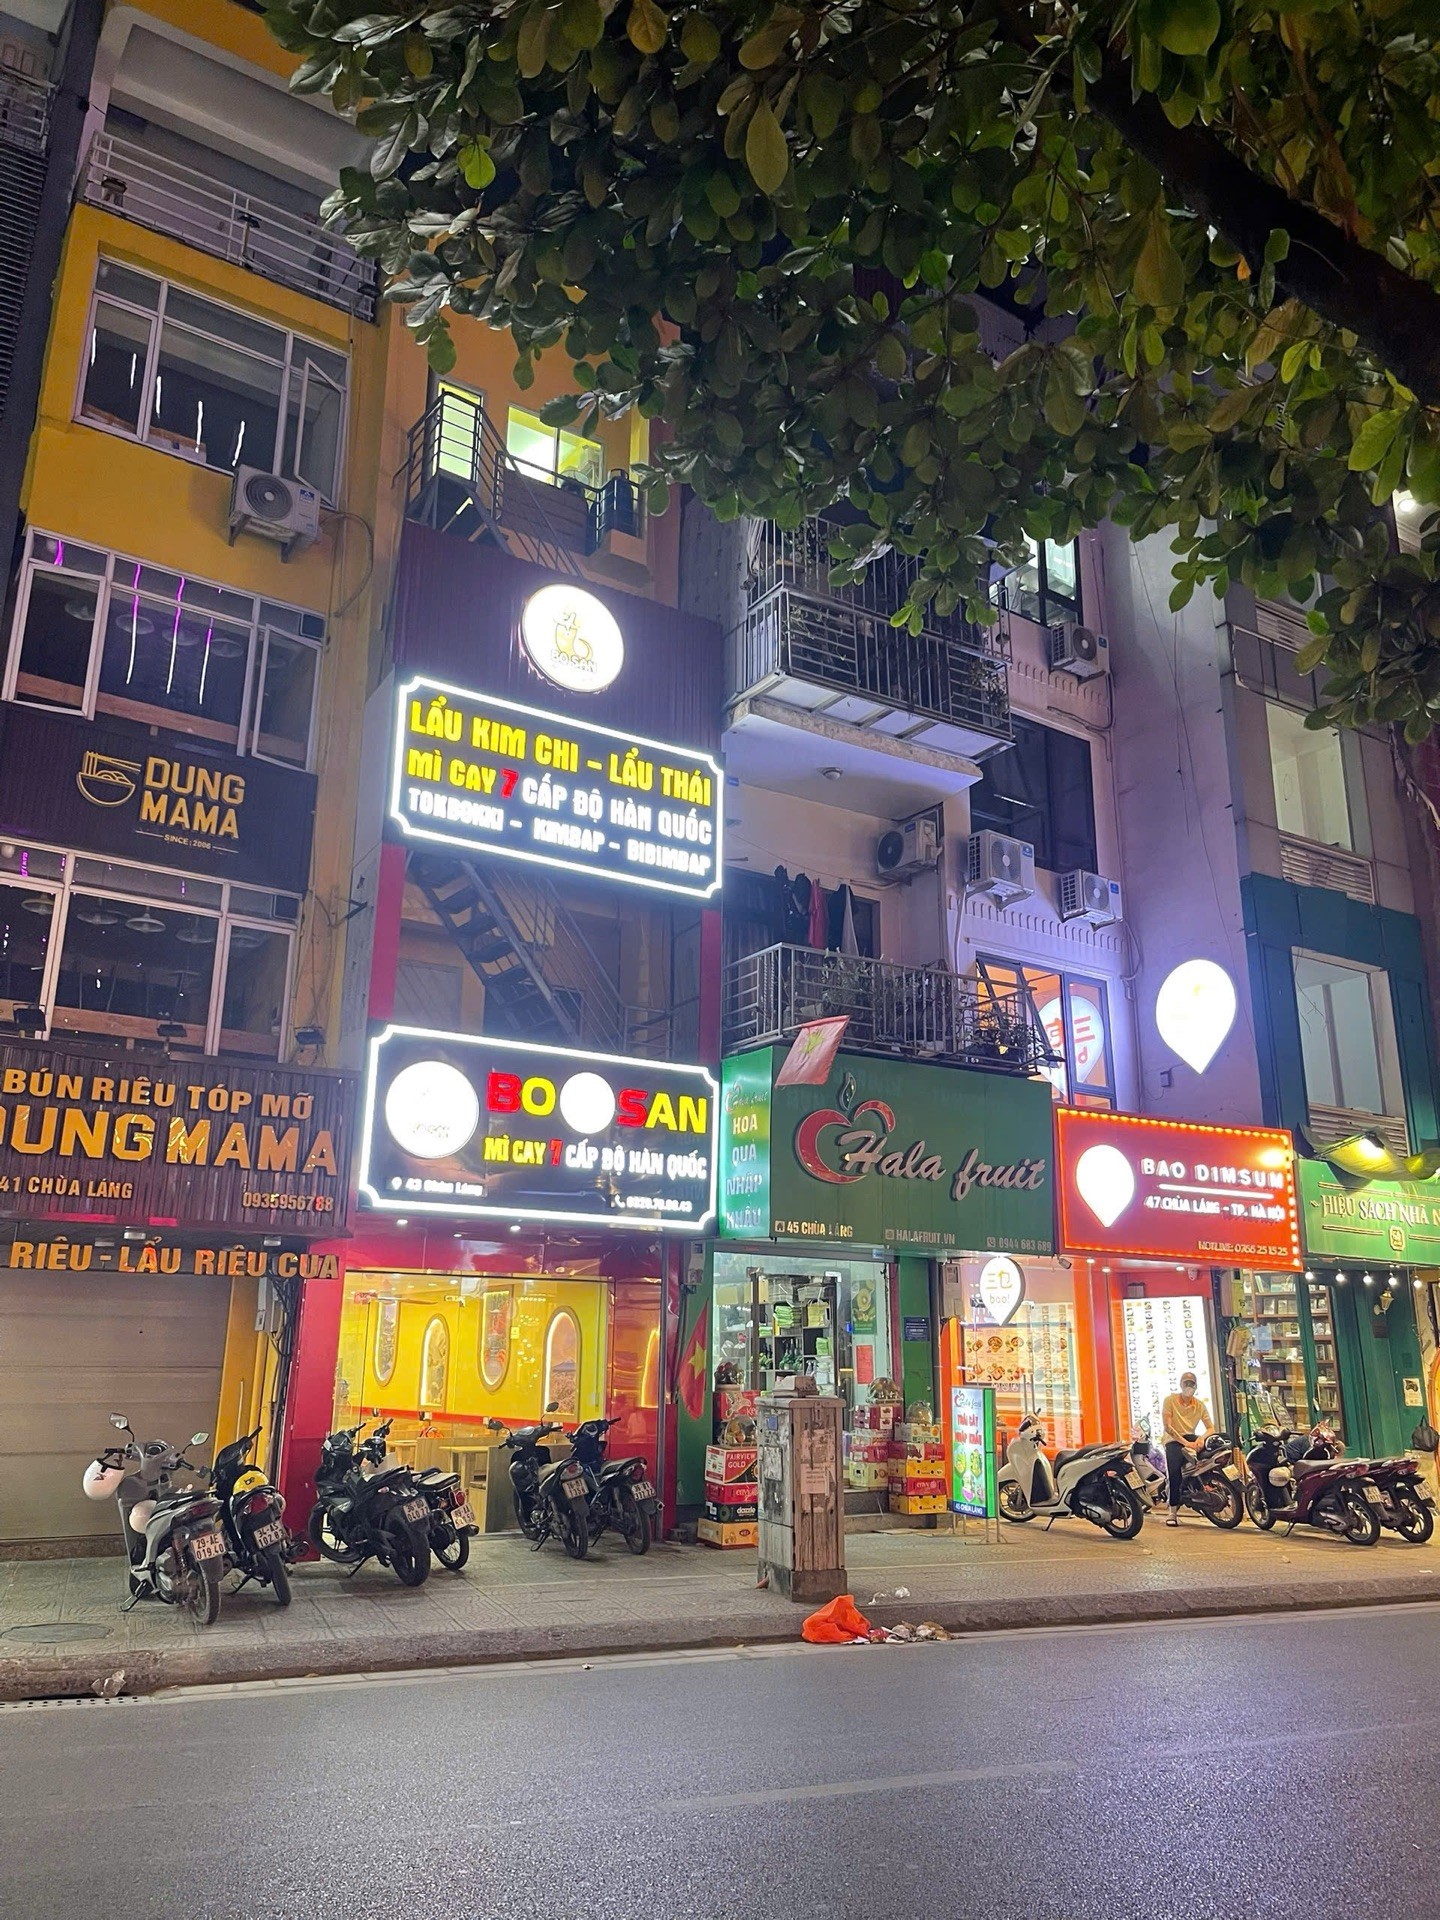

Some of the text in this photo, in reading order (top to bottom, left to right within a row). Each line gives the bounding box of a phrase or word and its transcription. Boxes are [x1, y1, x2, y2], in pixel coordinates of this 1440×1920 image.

[410, 695, 463, 742] LẨU
[472, 716, 526, 760] KIM
[535, 733, 579, 773] CHI
[609, 747, 653, 791] LẨU
[660, 766, 711, 807] THÁI
[145, 756, 245, 804] DUNG
[408, 748, 712, 845] MÌ CAY 7 CẤP ĐỘ HÀN QUỐC
[141, 790, 239, 839] MAMA
[408, 787, 504, 831] TOKBOKKI
[533, 817, 605, 853] KIMBAP
[627, 838, 711, 877] BIBIMBAP
[2, 1068, 315, 1120] BÚN RIÊU TÓP MỠ
[616, 1088, 707, 1134] SAN
[166, 1116, 337, 1176] MAMA
[732, 1114, 758, 1135] HOA
[484, 1134, 707, 1180] MÌ CAY 7 CẤP ĐỘ HÀN QUỐC
[838, 1130, 1046, 1201] Hala fruit
[1141, 1158, 1283, 1188] BAO DIMSUM
[0, 1175, 133, 1199] 41 CHÙA LÁNG
[1145, 1196, 1161, 1208] 47
[1322, 1194, 1355, 1217] HIỆU
[1359, 1199, 1395, 1220] SÁCH
[787, 1221, 800, 1234] 45
[801, 1221, 826, 1235] CHÙA
[9, 1235, 93, 1271] RIÊU
[118, 1236, 181, 1274] LẨU
[194, 1245, 268, 1277] RIÊU
[278, 1252, 339, 1279] CUA
[196, 1535, 219, 1549] 29-AE
[196, 1543, 225, 1559] 019.40
